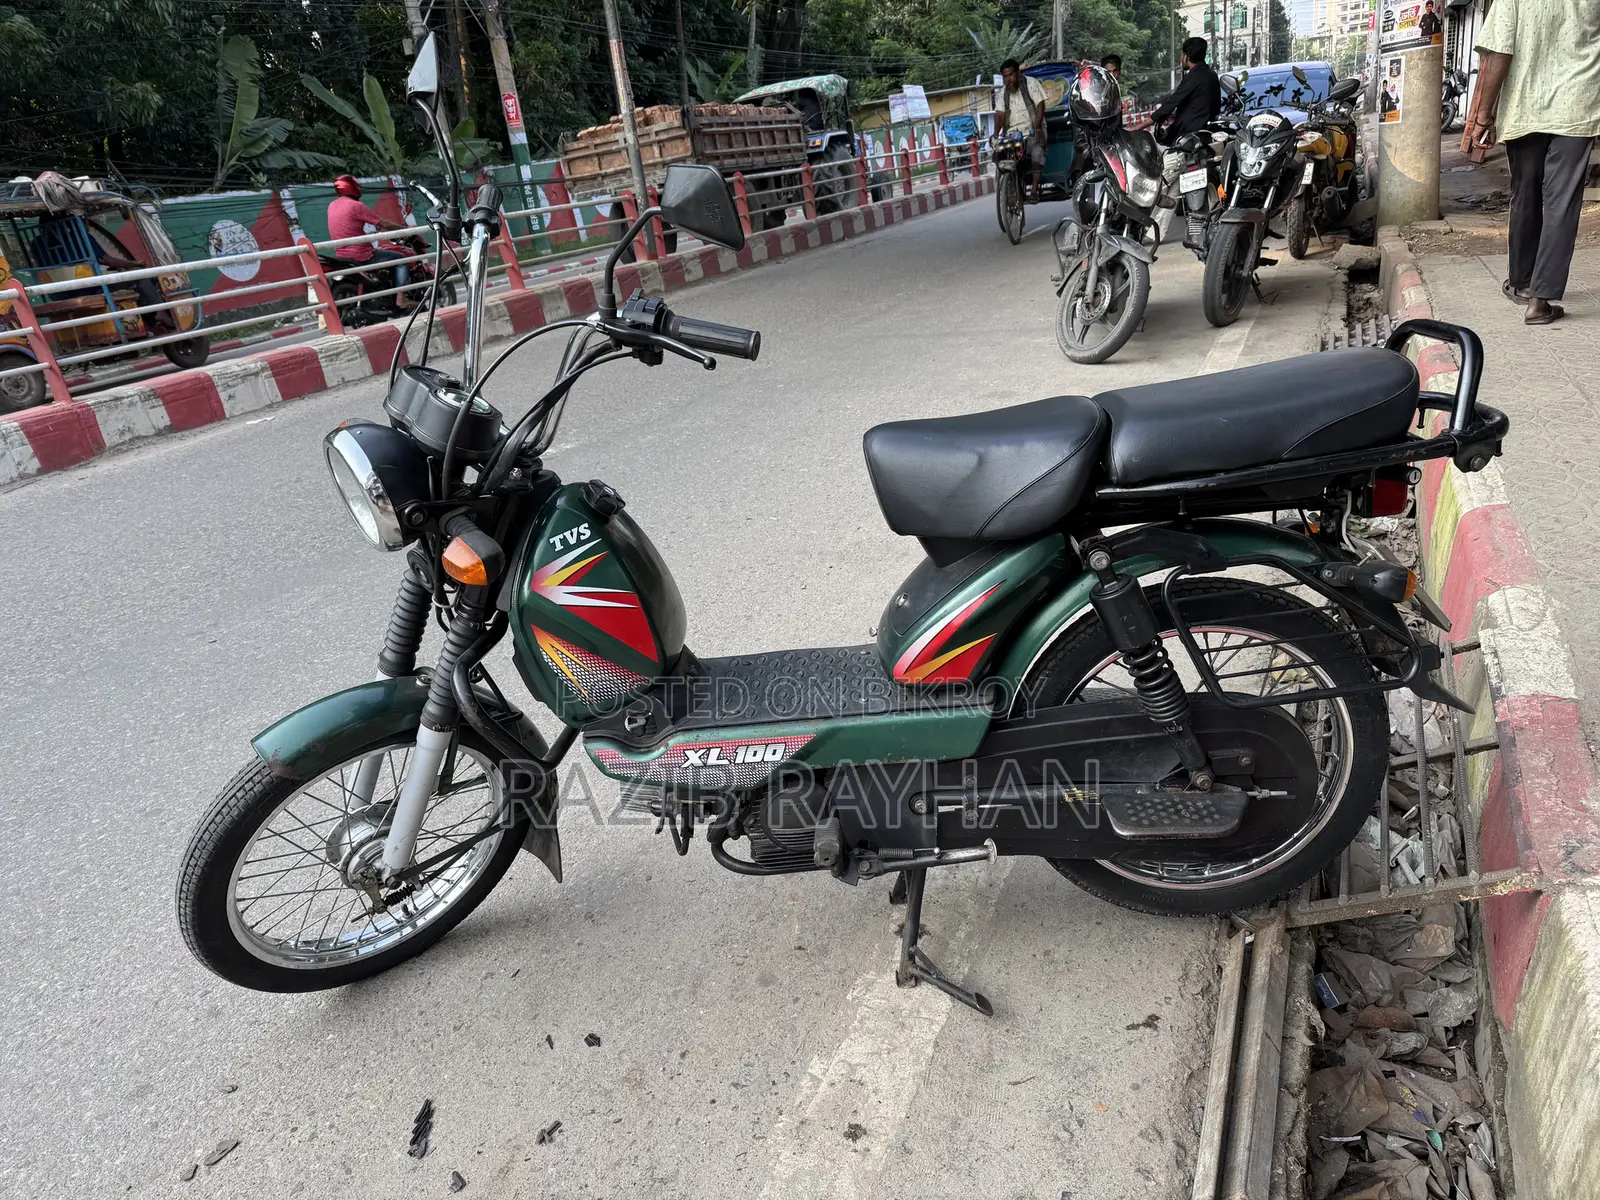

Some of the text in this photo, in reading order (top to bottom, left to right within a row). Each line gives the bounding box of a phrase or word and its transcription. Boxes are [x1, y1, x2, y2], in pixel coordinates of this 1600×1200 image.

[549, 523, 591, 552] TVS
[680, 743, 786, 768] XL 100
